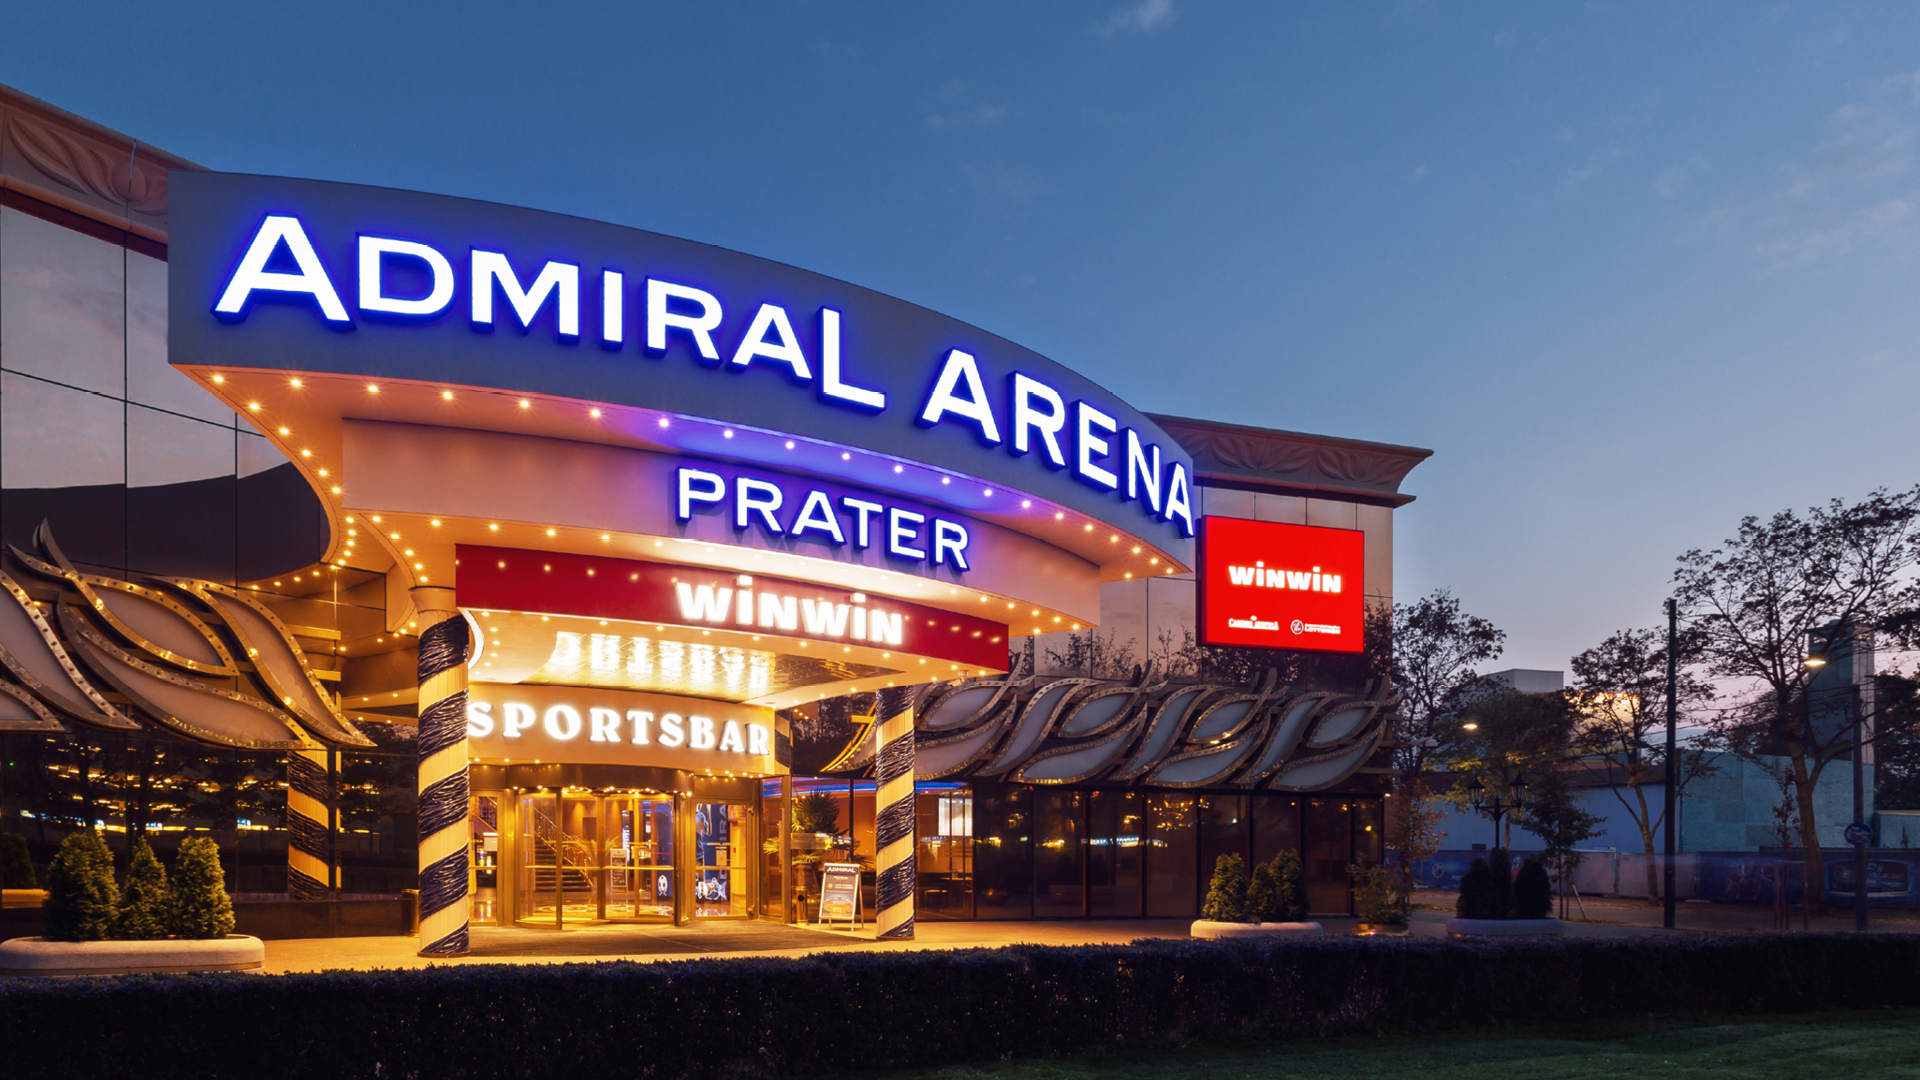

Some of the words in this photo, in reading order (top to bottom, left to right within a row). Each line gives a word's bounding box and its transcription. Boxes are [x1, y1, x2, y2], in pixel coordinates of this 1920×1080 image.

[215, 215, 886, 409] ADMIRAL
[921, 349, 1195, 537] ARENA
[678, 467, 969, 570] PRATER
[467, 701, 770, 756] SPORTSBAR
